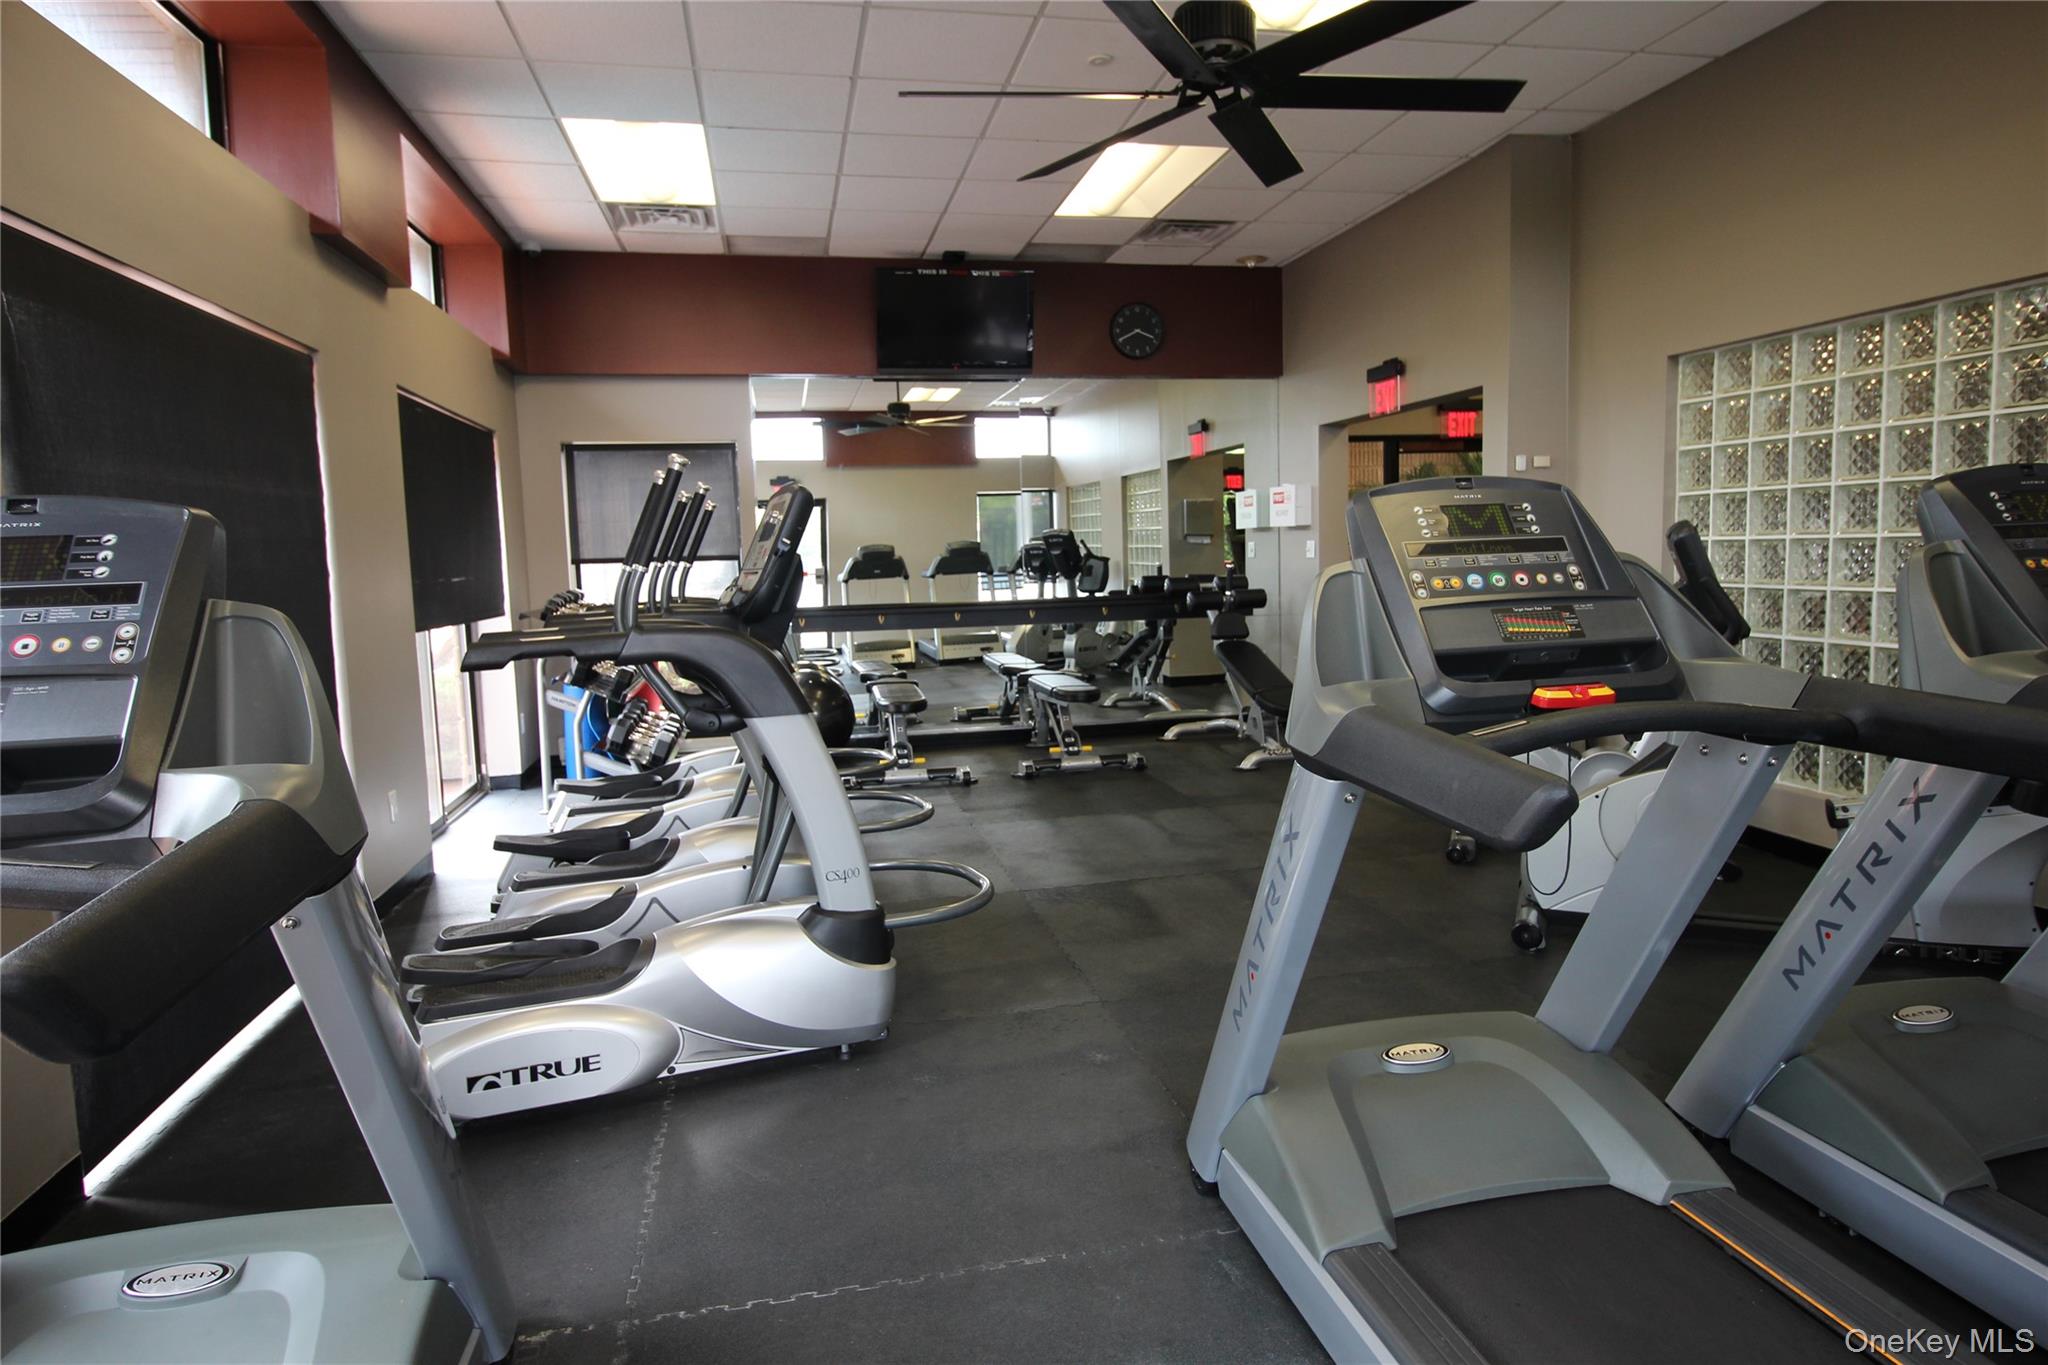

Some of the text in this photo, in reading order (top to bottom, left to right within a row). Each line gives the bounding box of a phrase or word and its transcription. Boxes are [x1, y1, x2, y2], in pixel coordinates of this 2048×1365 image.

[1447, 411, 1478, 438] EXIT
[825, 867, 860, 883] CS400
[1782, 776, 1938, 992] MATRIX
[1232, 812, 1300, 1033] MATRIX
[1391, 1046, 1442, 1057] MATRIX
[502, 1054, 601, 1086] TRUE
[136, 1269, 220, 1286] MATRIX
